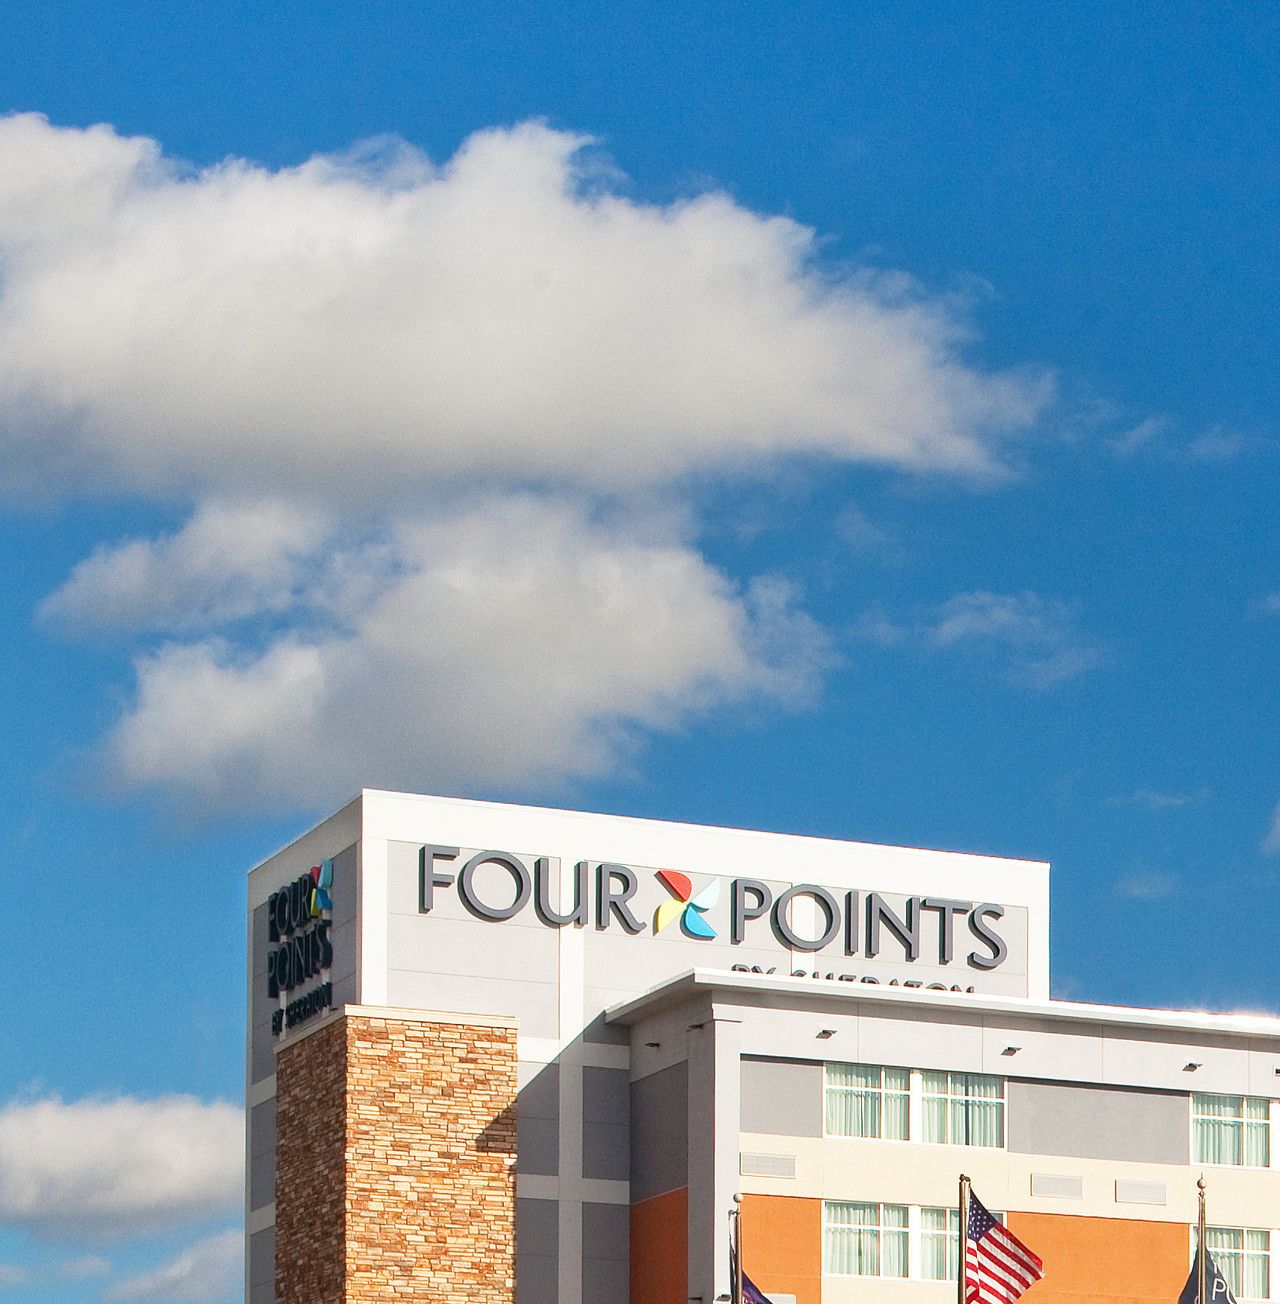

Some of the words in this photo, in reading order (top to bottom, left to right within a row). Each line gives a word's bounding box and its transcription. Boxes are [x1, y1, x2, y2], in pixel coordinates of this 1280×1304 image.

[268, 872, 315, 943] FOUR
[418, 844, 648, 936] FOUR
[730, 878, 1008, 971] POINTS
[268, 919, 334, 998] POINTS
